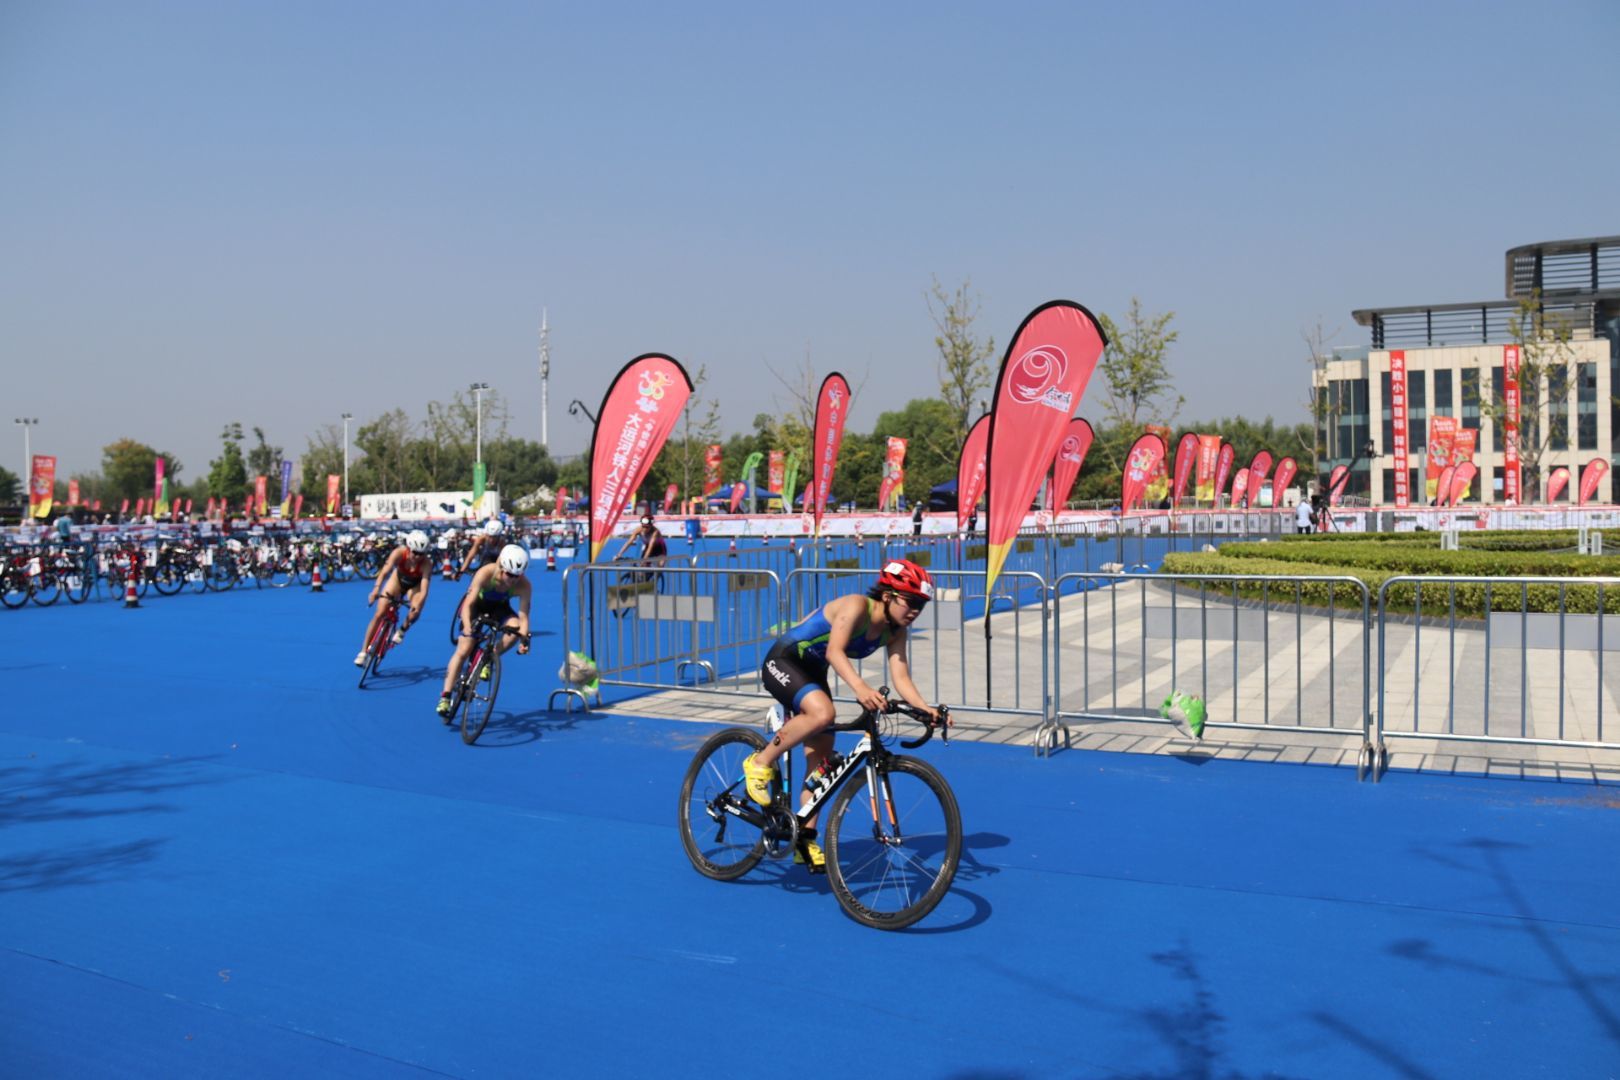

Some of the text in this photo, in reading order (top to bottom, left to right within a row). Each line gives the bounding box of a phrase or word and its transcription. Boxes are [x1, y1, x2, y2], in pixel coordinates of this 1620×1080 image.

[594, 413, 642, 524] 大运河铁人三项赛
[766, 660, 791, 687] Santic
